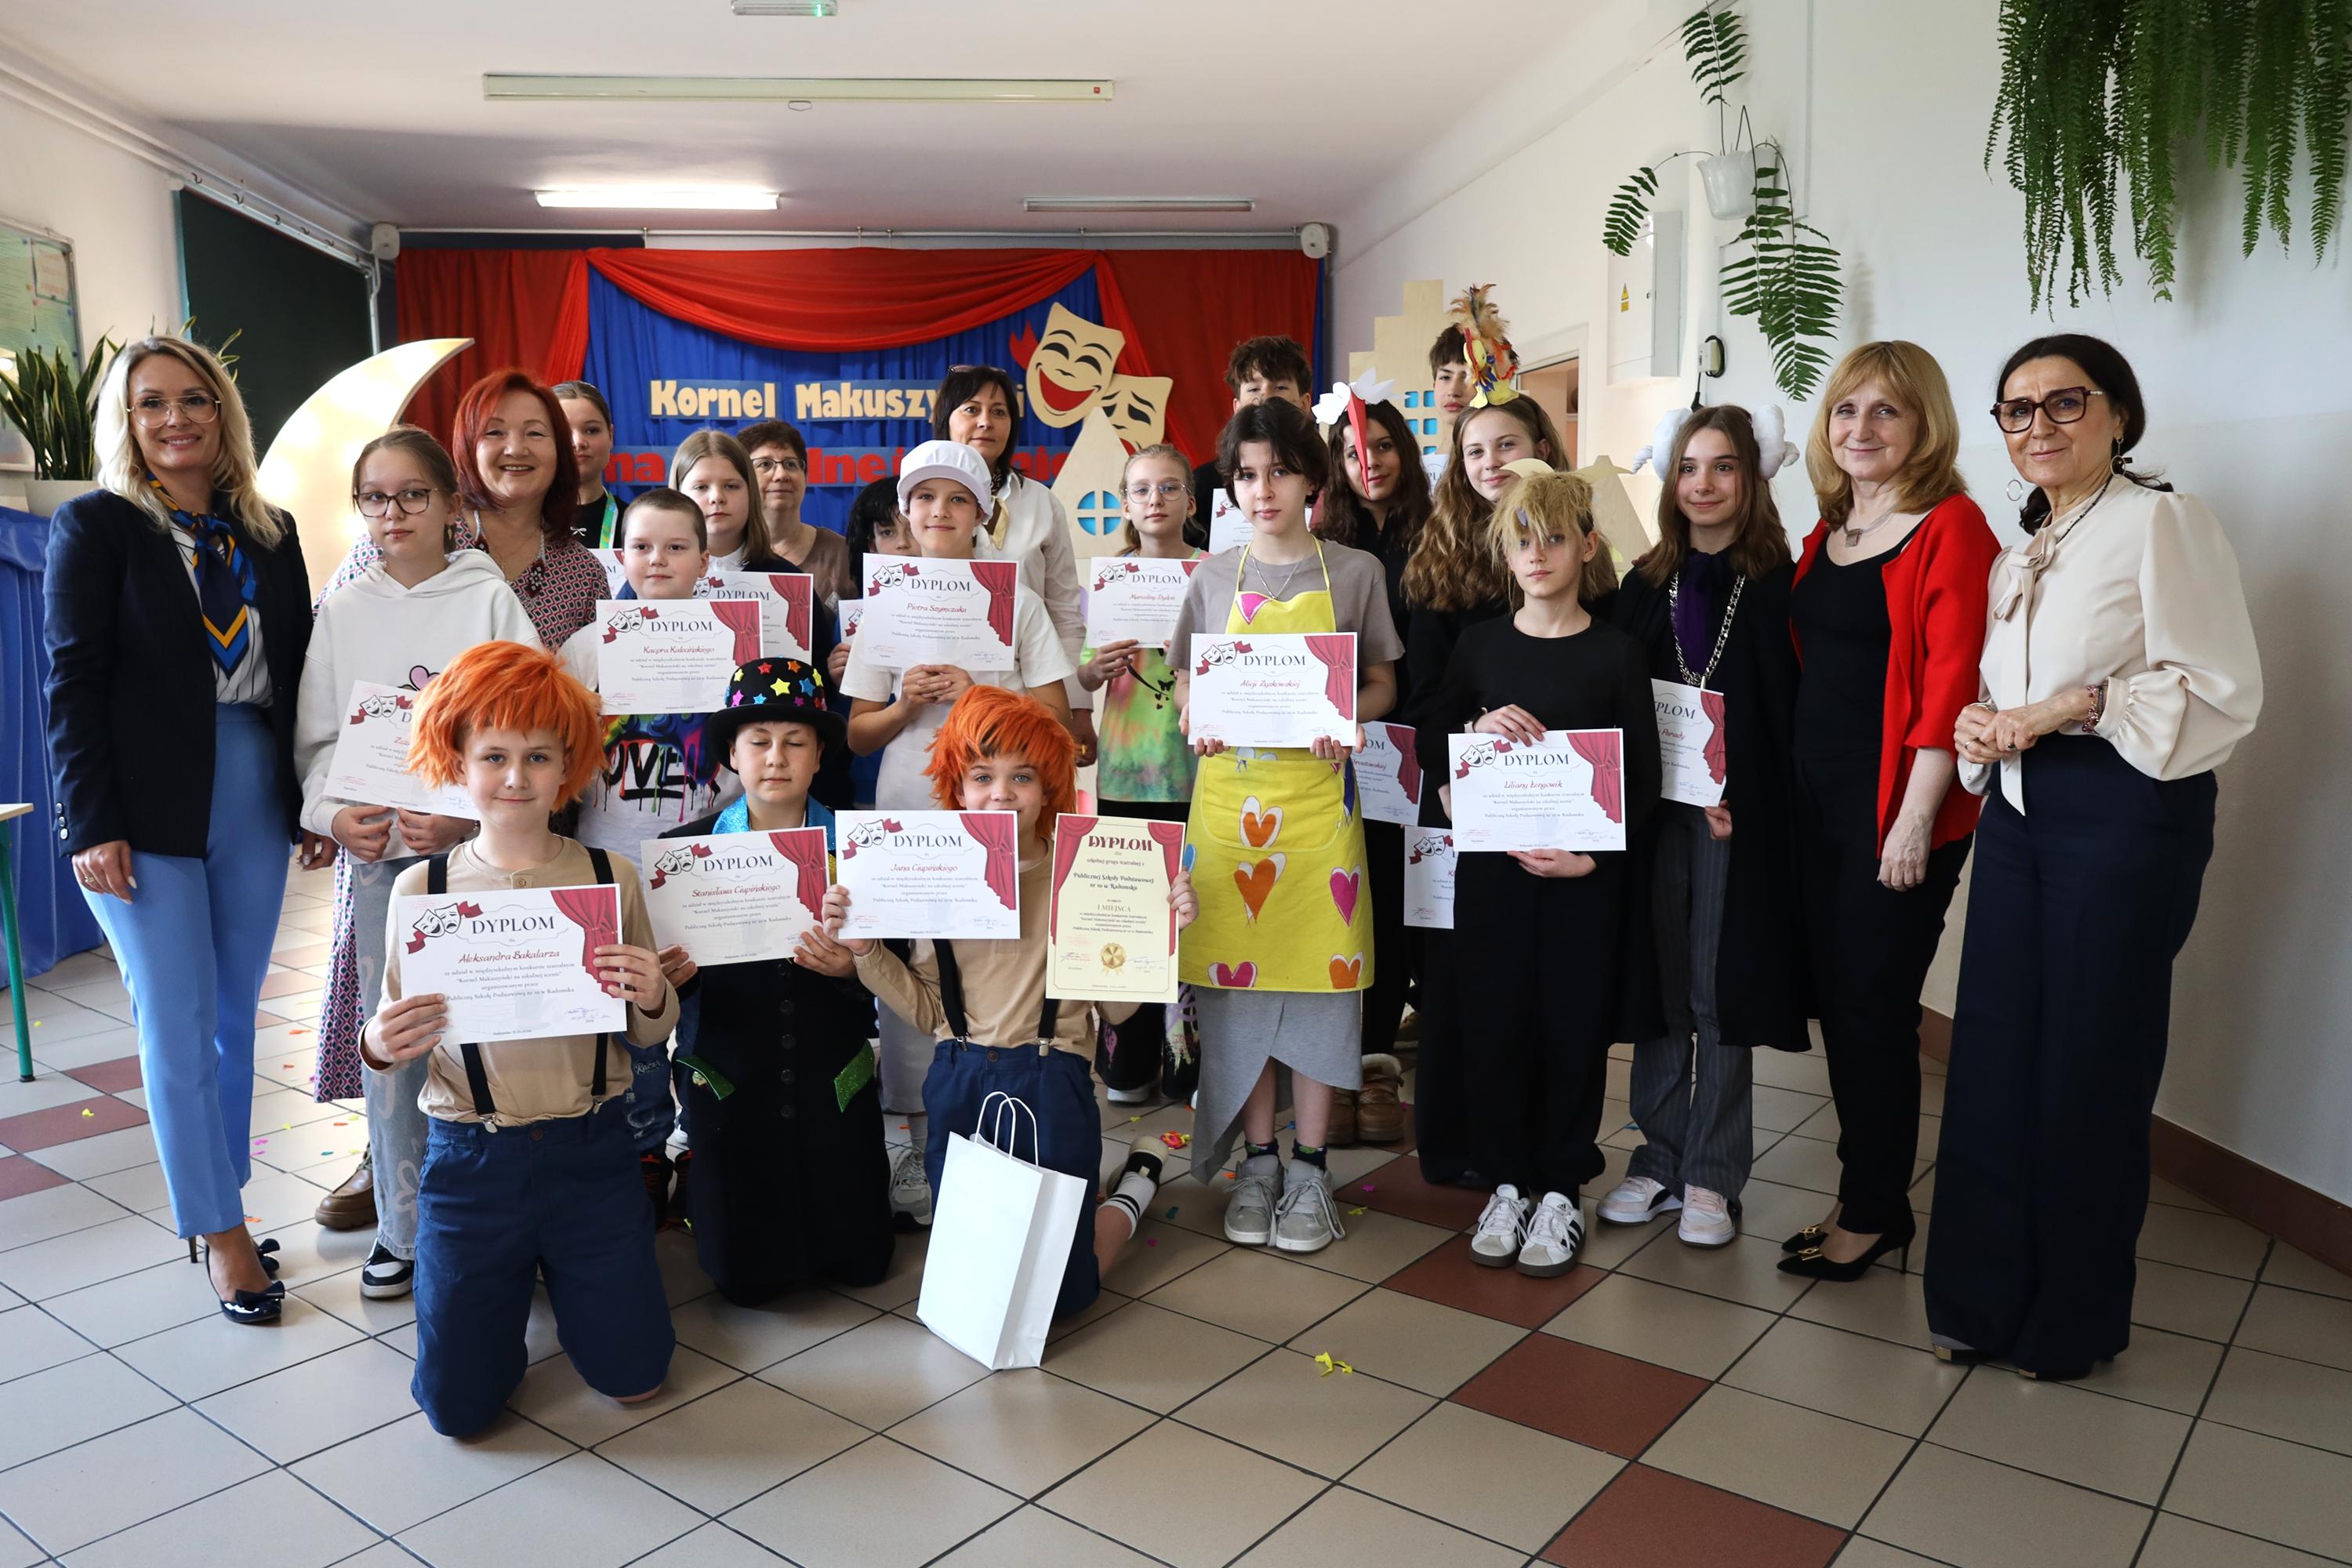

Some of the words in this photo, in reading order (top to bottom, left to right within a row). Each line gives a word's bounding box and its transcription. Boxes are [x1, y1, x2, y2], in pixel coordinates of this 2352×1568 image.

[651, 379, 775, 419] Kornel
[604, 452, 666, 483] na
[912, 579, 971, 591] DYPLOM
[1132, 574, 1181, 585] DYPLOM
[907, 603, 927, 612] Piotra
[652, 621, 713, 632] DYPLOM
[1244, 655, 1306, 666] DYPLOM
[1504, 753, 1569, 766] DYPLOM
[894, 835, 962, 848] DYPLOM
[1088, 836, 1152, 852] DYPLOM
[704, 855, 773, 872] DYPLOM
[691, 886, 732, 898] Stanisława
[734, 883, 781, 895] Ciupińskiego
[472, 916, 554, 934] DYPLOM
[458, 951, 511, 964] Aleksandra
[512, 948, 560, 960] Bakalarza
